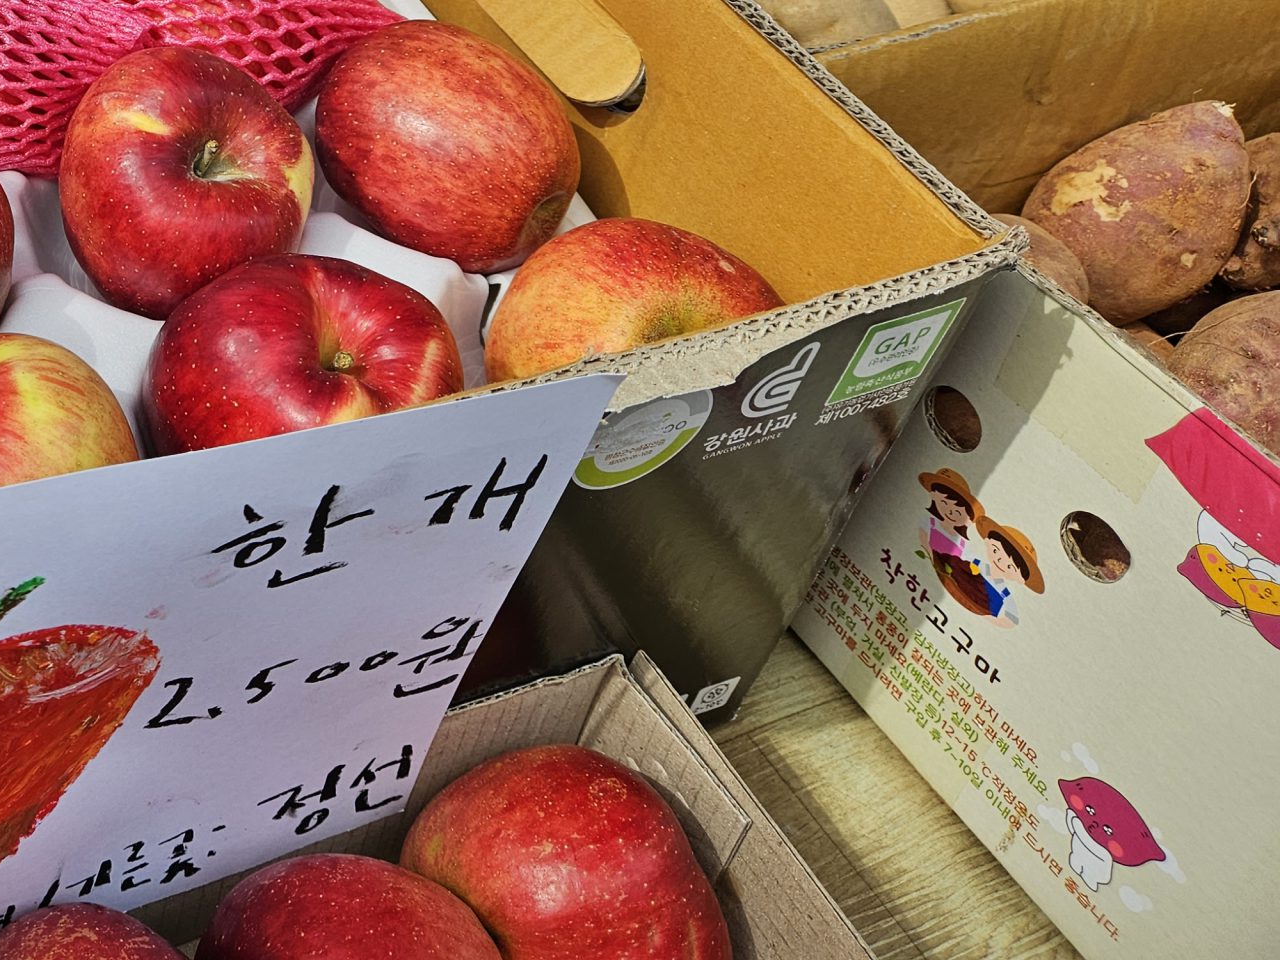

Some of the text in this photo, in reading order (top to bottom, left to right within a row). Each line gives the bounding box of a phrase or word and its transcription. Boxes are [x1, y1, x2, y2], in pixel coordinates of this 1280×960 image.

[874, 326, 931, 355] GAP
[704, 412, 797, 451] 강원사과
[702, 441, 753, 460] GANGWON
